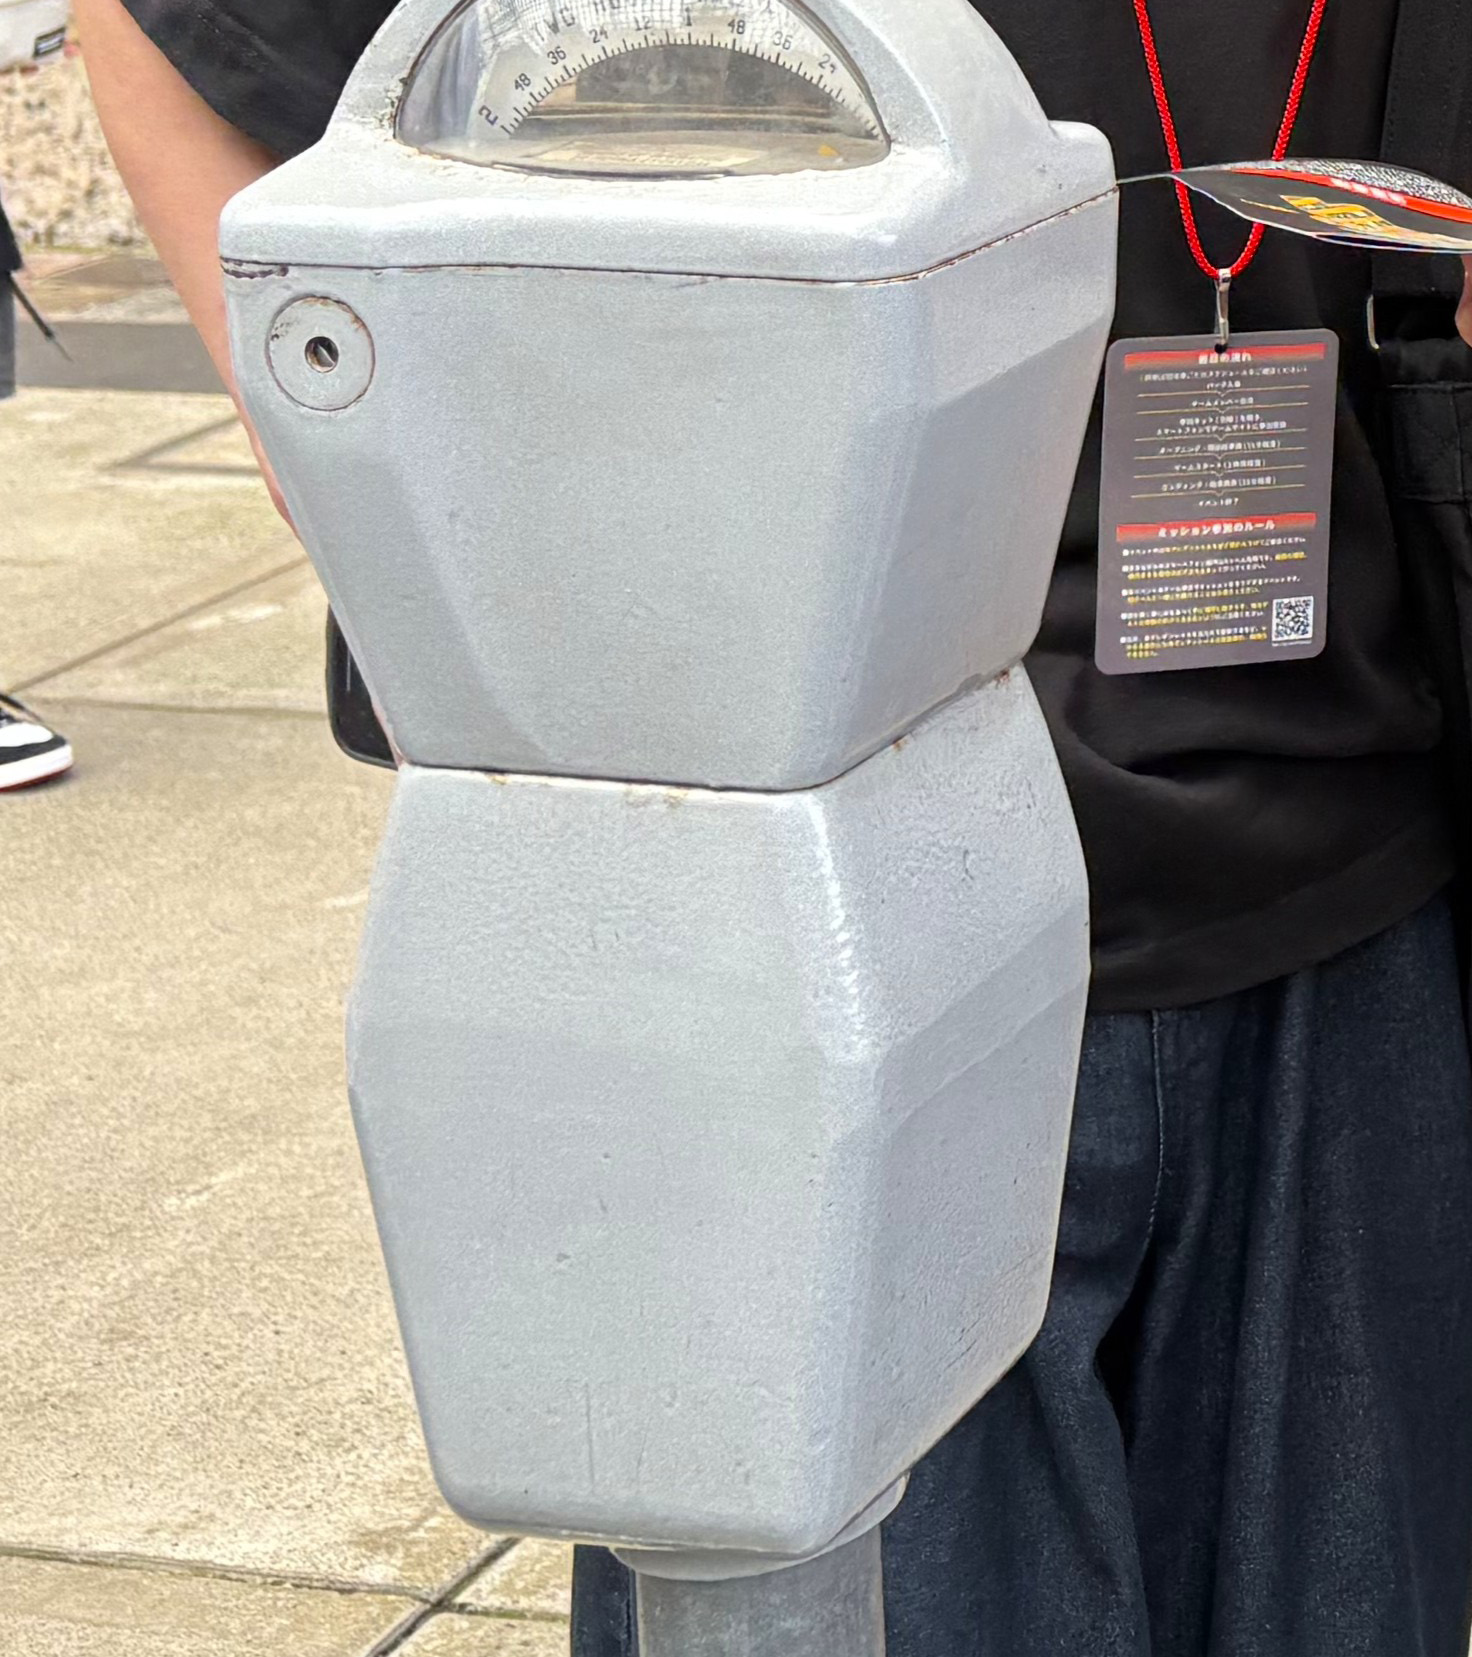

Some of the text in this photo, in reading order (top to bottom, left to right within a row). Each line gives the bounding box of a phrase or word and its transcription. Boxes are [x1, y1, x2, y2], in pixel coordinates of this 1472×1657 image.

[478, 105, 499, 127] 2
[512, 72, 532, 92] 48
[546, 46, 567, 66] 36
[589, 28, 609, 44] 24
[635, 15, 652, 31] 12
[685, 7, 693, 28] 1
[727, 17, 747, 36] 48
[774, 31, 793, 49] 36
